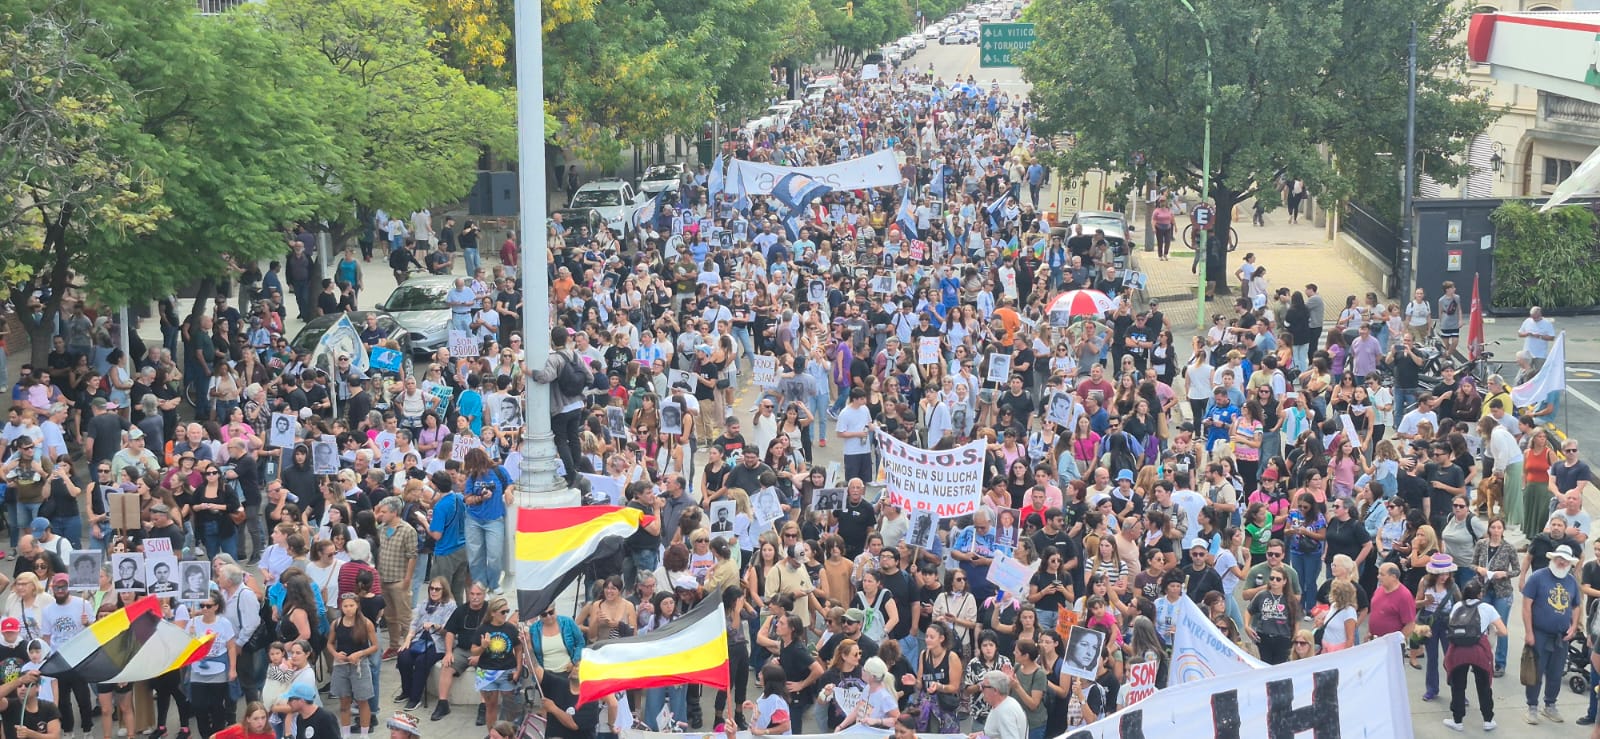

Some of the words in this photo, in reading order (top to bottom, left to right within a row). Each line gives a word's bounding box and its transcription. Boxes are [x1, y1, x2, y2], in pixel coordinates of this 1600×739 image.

[993, 28, 1003, 37] LA
[1008, 28, 1036, 37] VITICO
[994, 41, 1031, 50] TORNQUIS
[1197, 208, 1208, 224] E
[456, 338, 472, 346] SON
[453, 345, 478, 356] 30000
[916, 467, 928, 480] EN
[931, 470, 943, 482] SU
[946, 470, 978, 483] LUCHA
[904, 480, 915, 492] EN
[918, 482, 930, 495] LA
[932, 484, 976, 497] NUESTRA
[147, 539, 170, 552] SON
[1130, 660, 1156, 687] SON
